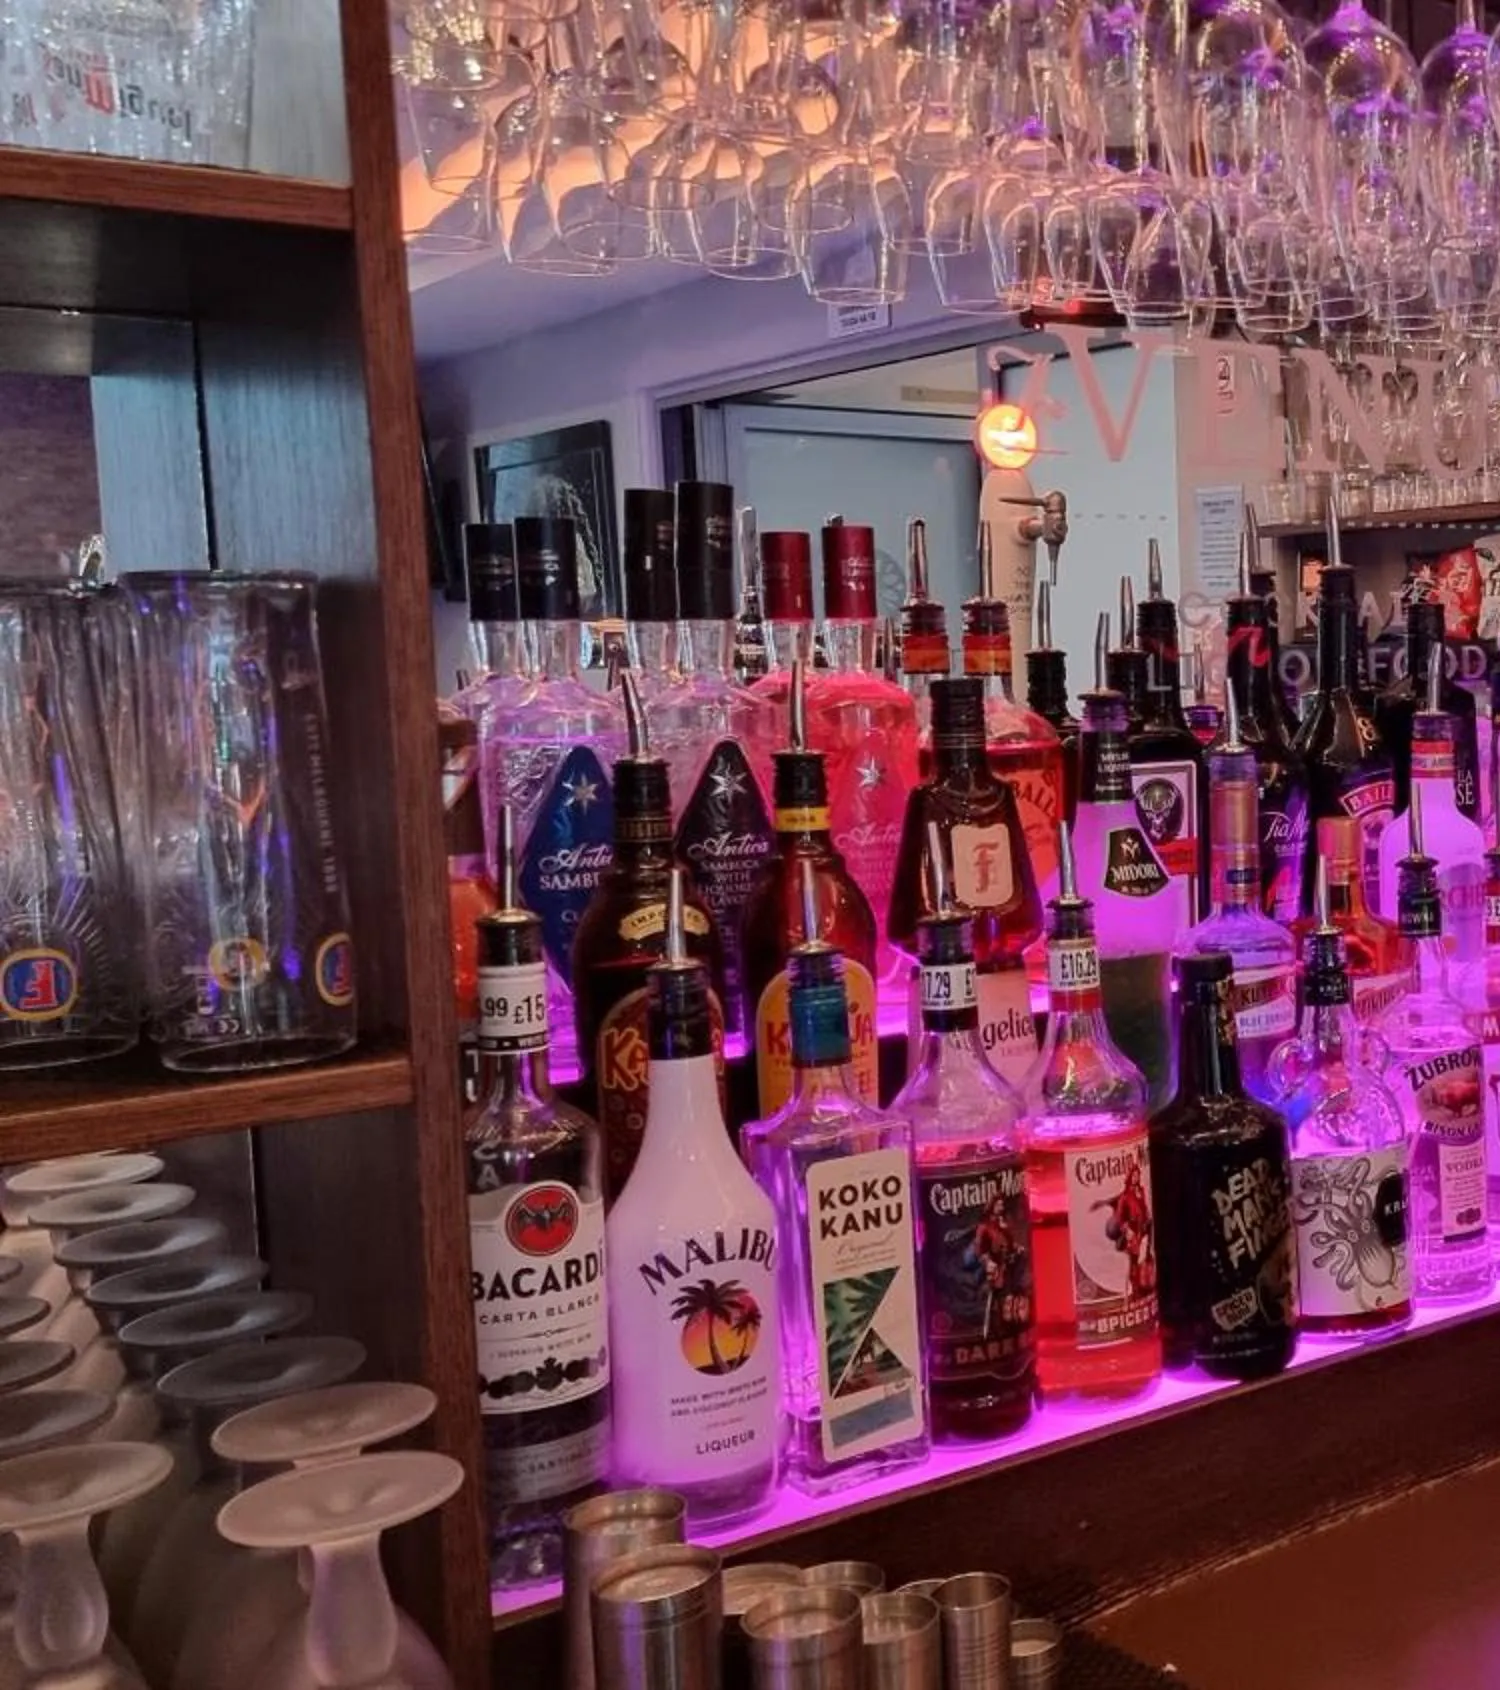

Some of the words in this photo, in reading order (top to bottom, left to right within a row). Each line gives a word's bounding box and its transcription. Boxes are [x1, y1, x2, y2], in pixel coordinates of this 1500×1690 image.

[1110, 863, 1160, 883] MIDORI
[1075, 1151, 1134, 1186] Captain
[818, 1174, 903, 1211] KOKO
[930, 1175, 997, 1215] Captain
[819, 1202, 904, 1241] KANU
[479, 1310, 538, 1326] CARTA
[696, 1429, 755, 1455] LIQUEUR
